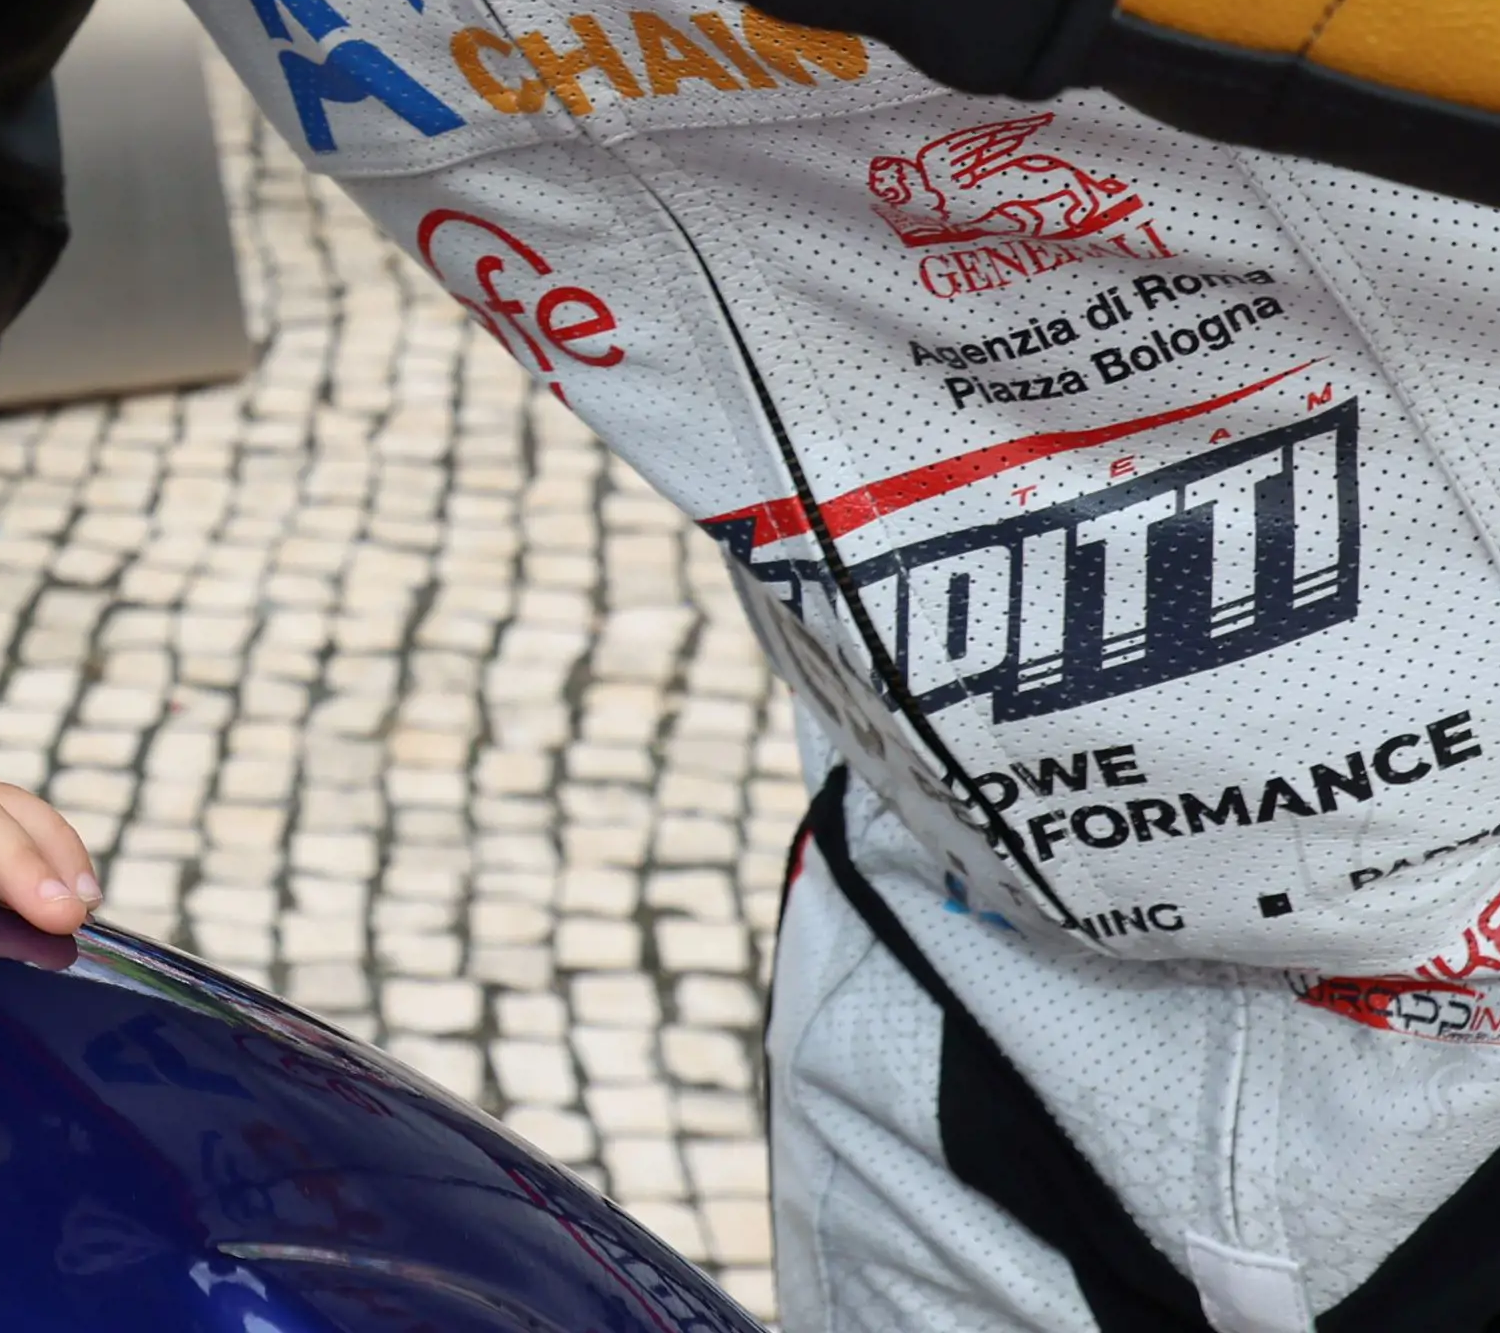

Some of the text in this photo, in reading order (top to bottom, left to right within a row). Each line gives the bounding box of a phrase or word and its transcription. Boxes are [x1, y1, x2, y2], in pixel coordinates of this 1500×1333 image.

[909, 268, 1276, 370] Agenzia di Roma
[944, 294, 1284, 411] Piazza Bologna
[1000, 709, 1483, 863] FORMANCE
